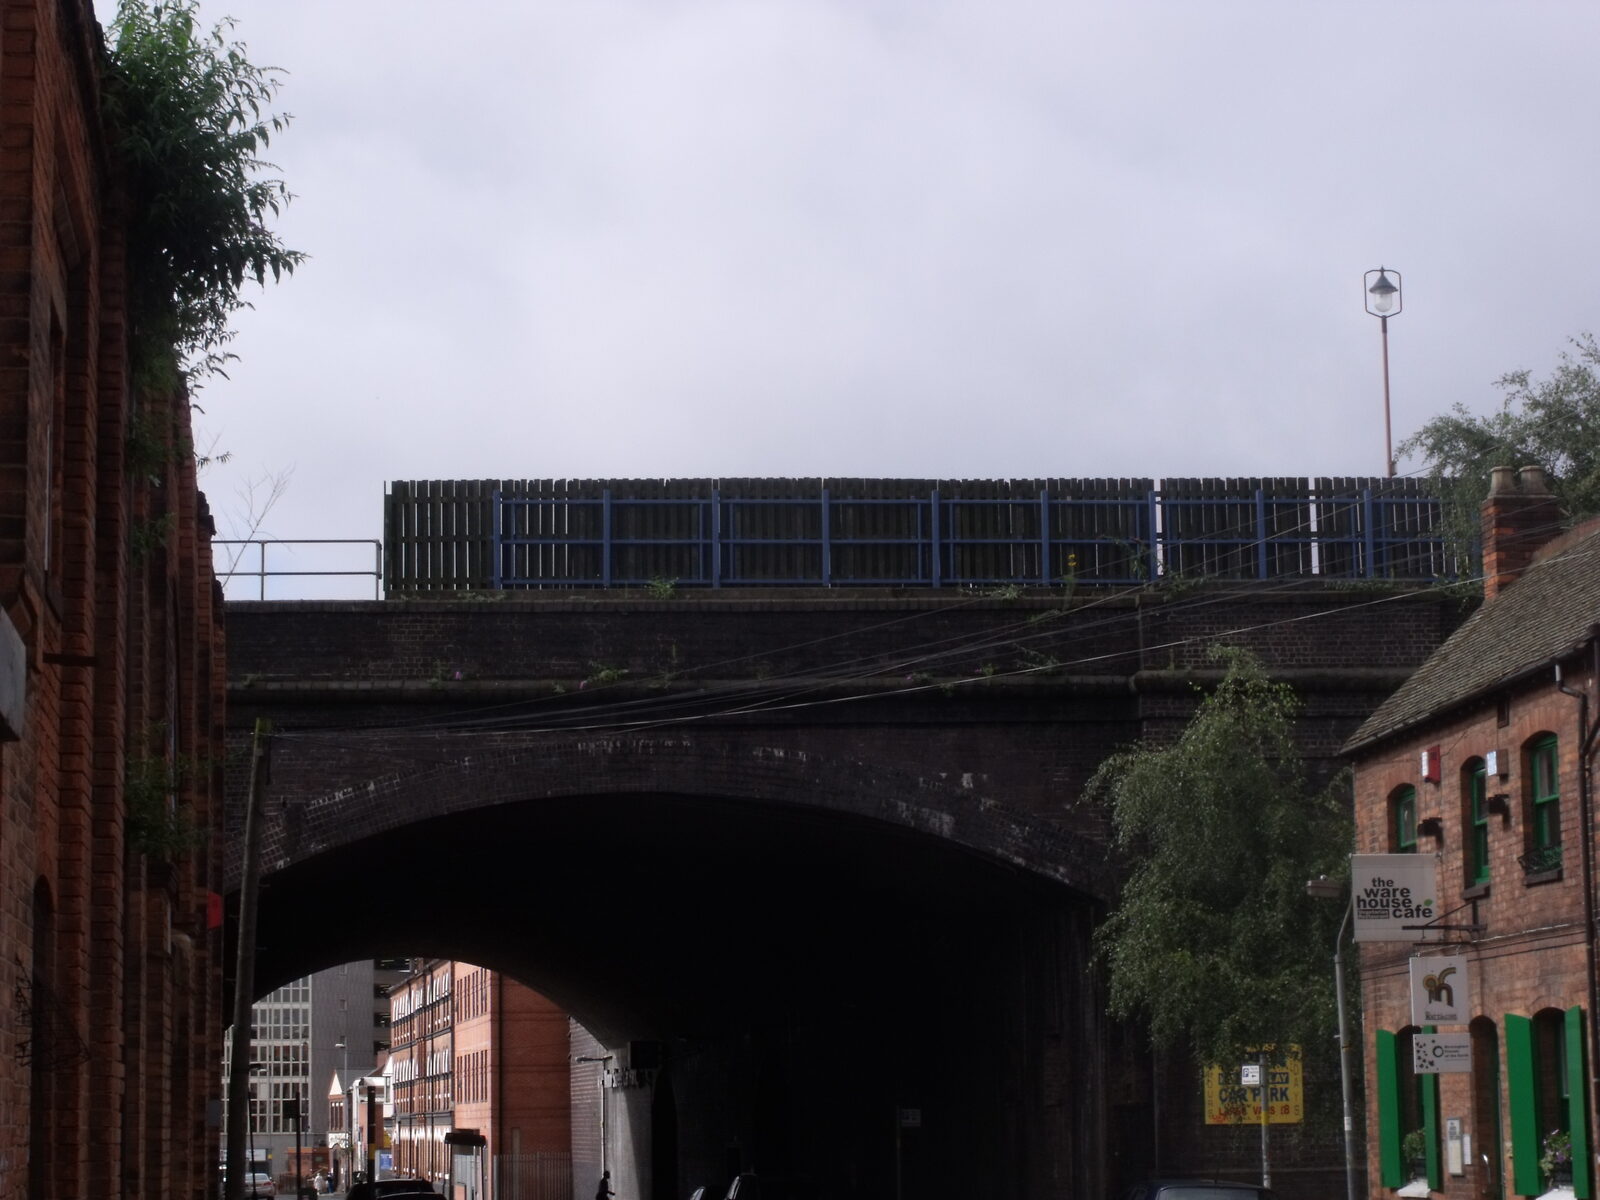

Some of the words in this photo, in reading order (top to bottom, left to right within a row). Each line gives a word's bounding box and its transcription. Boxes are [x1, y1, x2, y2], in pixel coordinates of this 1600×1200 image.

[1372, 877, 1394, 888] the
[1364, 887, 1411, 898] ware
[1356, 895, 1413, 909] house
[1251, 1087, 1290, 1102] PRK
